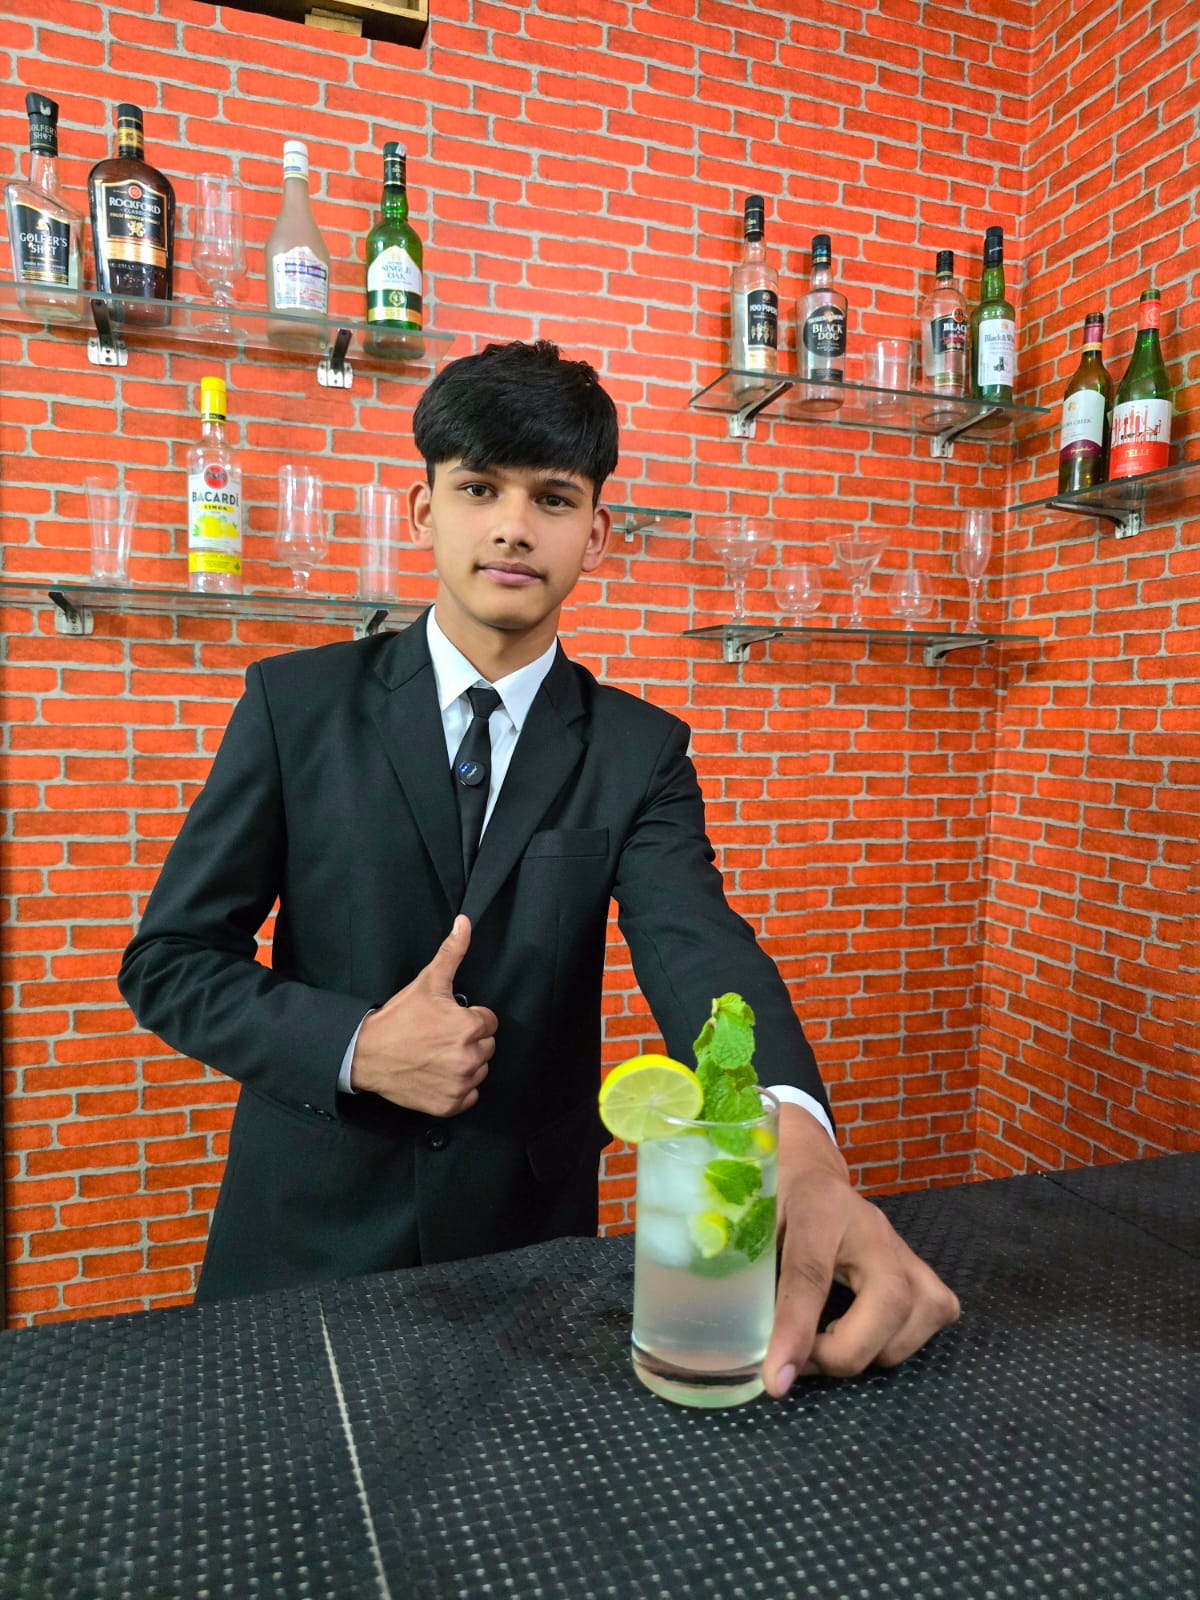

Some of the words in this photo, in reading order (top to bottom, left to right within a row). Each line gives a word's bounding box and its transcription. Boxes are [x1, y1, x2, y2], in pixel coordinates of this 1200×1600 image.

[109, 196, 161, 215] ROCKFORD
[19, 232, 68, 248] GOLFER'S
[31, 244, 57, 256] SHT
[812, 323, 844, 335] BLACK
[943, 322, 967, 333] BLAC
[817, 332, 840, 341] DOG
